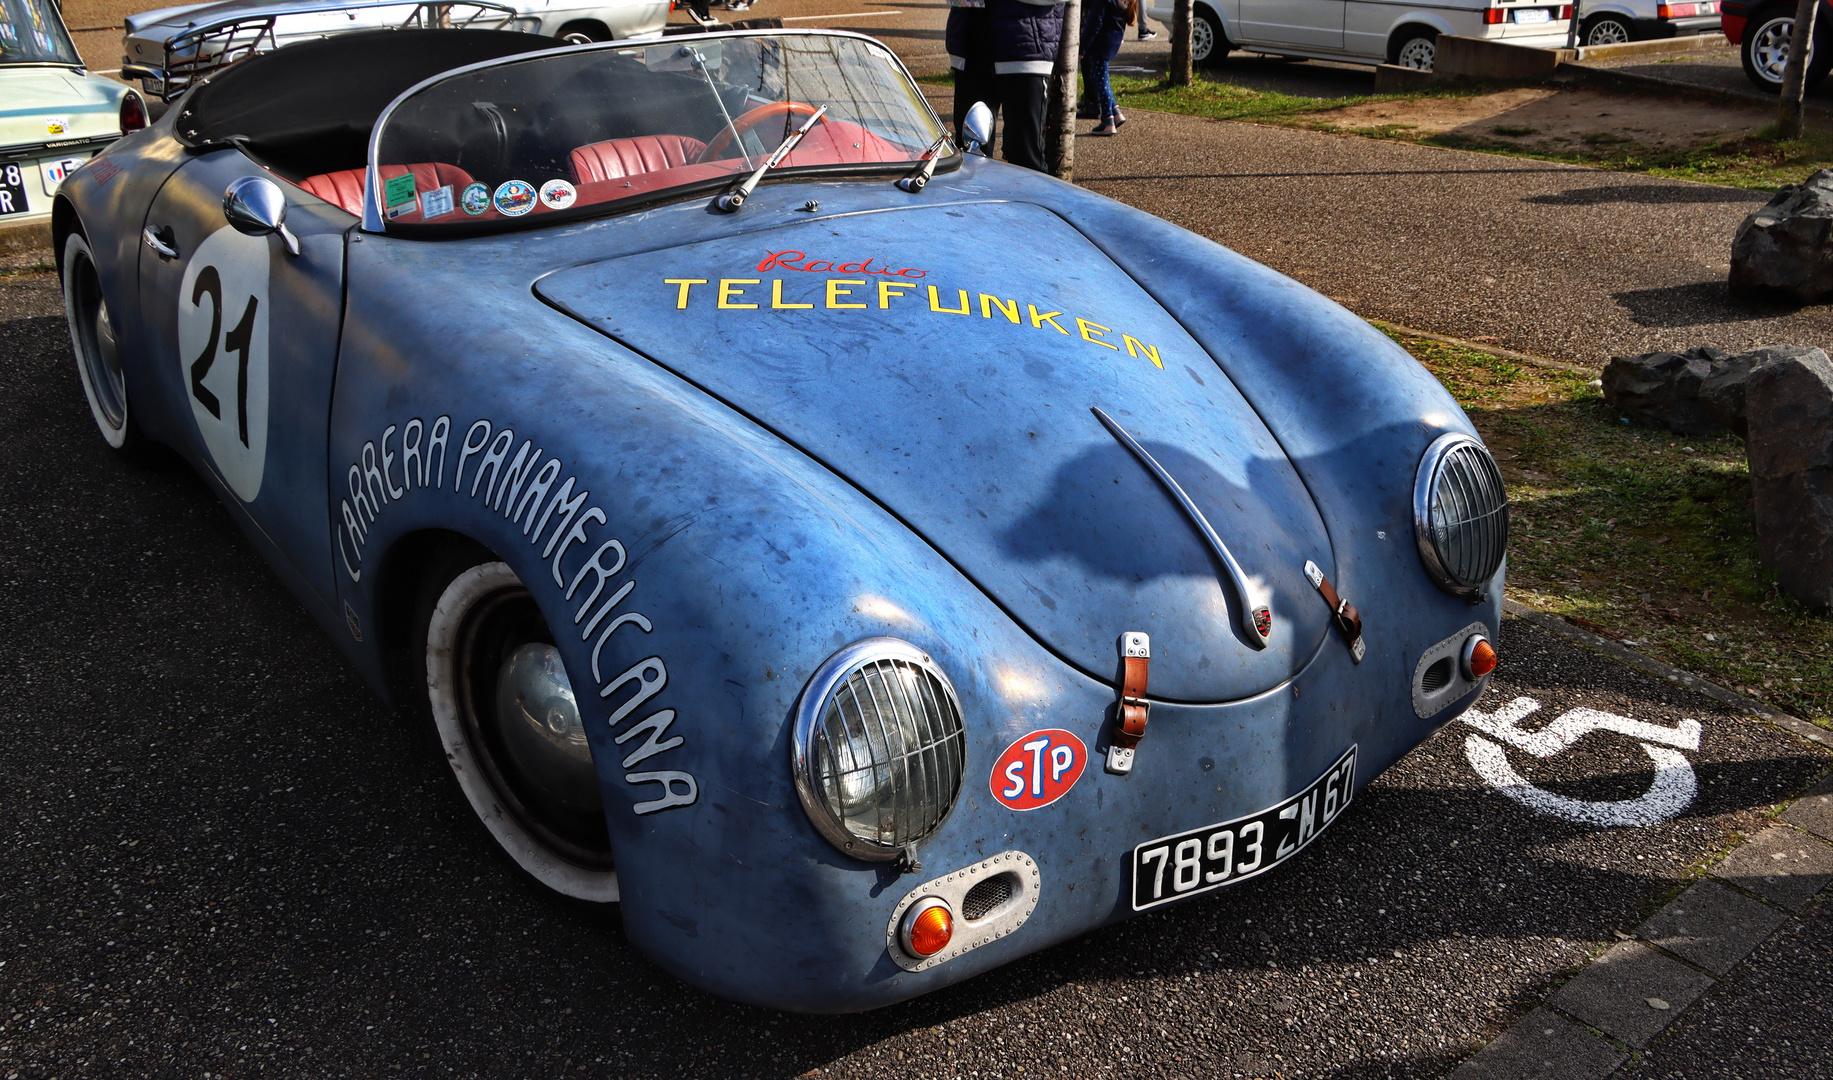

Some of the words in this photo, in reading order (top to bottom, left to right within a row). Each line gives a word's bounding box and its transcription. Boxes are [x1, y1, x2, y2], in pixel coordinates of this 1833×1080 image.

[46, 139, 91, 149] VARIOMATIC
[757, 249, 930, 278] Radio
[191, 265, 258, 450] 21
[664, 278, 1165, 371] TELEFUNKEN
[338, 415, 451, 582] CARRERA
[455, 419, 700, 816] PANAMERICANA
[1003, 736, 1075, 800] STP
[1142, 820, 1265, 899] 7893
[1323, 754, 1354, 823] 67
